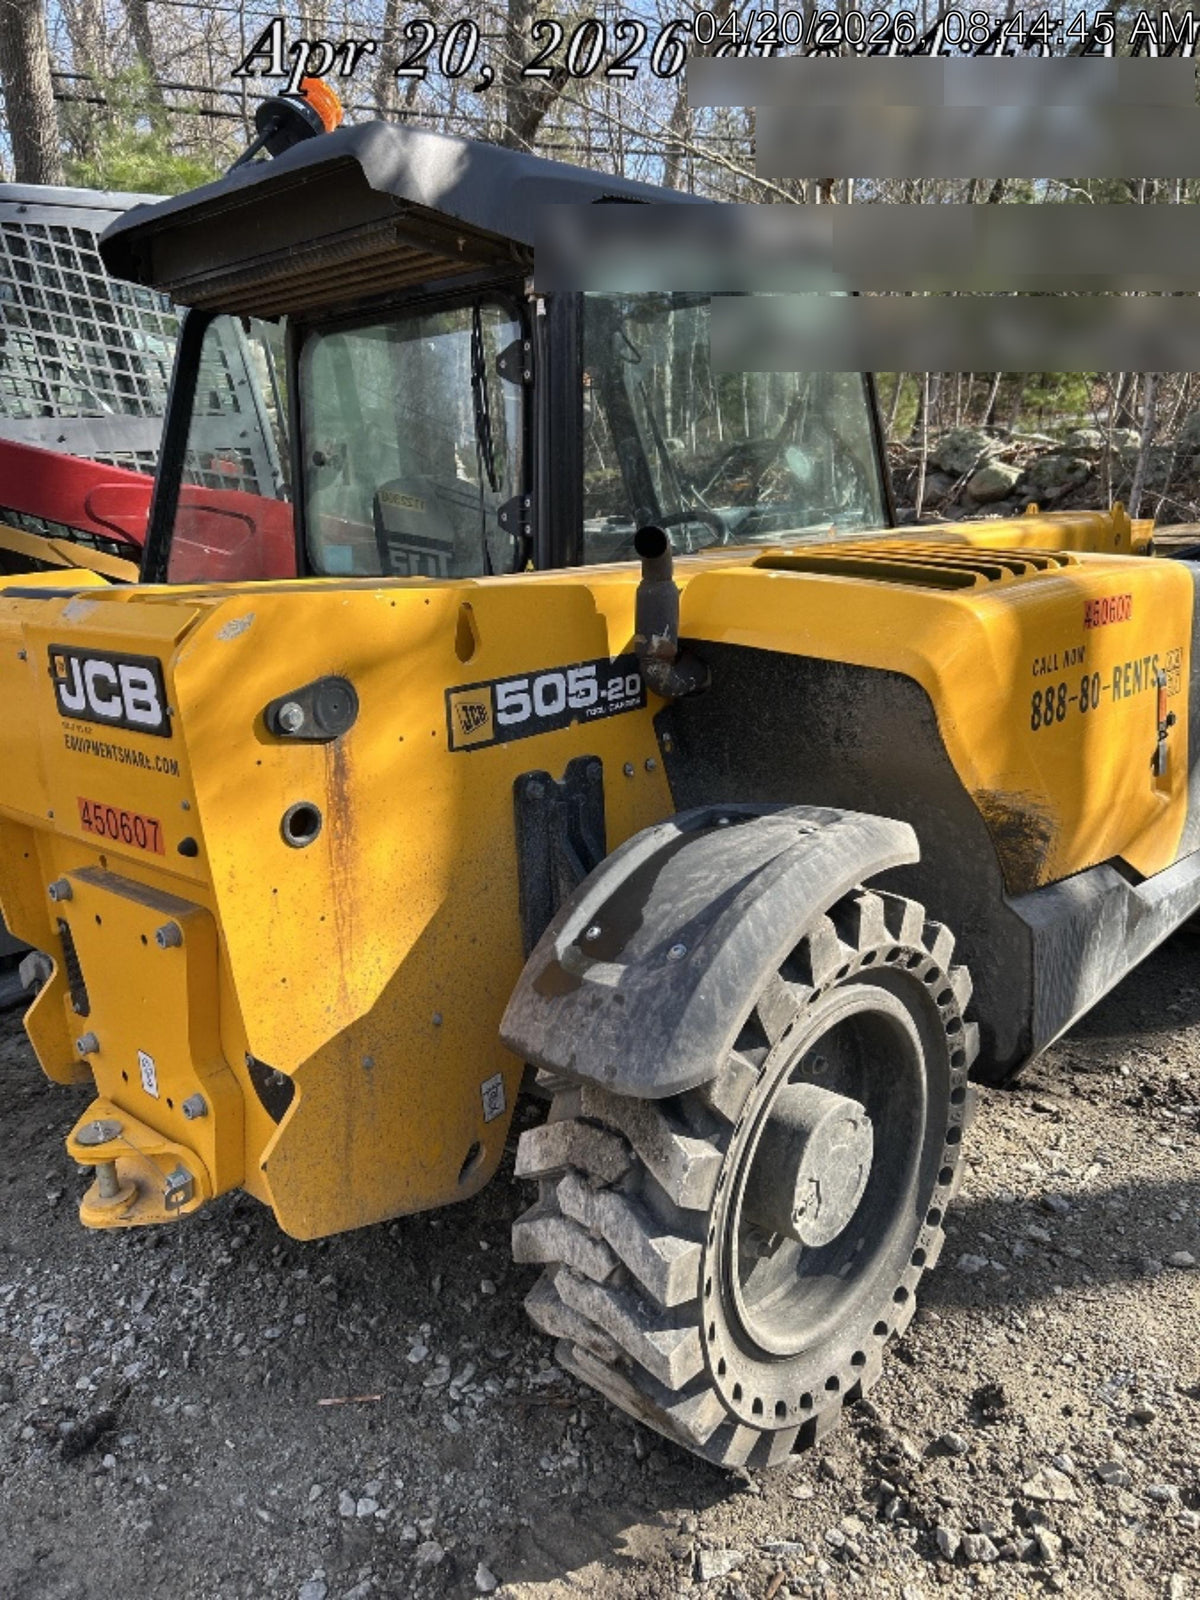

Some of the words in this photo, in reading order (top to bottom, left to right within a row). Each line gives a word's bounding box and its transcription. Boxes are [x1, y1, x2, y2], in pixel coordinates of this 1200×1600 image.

[1032, 653, 1059, 677] CALL
[1062, 645, 1087, 669] NOW
[58, 657, 163, 725] JCB
[496, 665, 641, 726] 505-20
[1030, 653, 1160, 732] 888-80-RENTS
[461, 704, 487, 732] JCB
[64, 734, 180, 778] EQUIPMENTSHARE.COM
[81, 801, 159, 853] 450607
